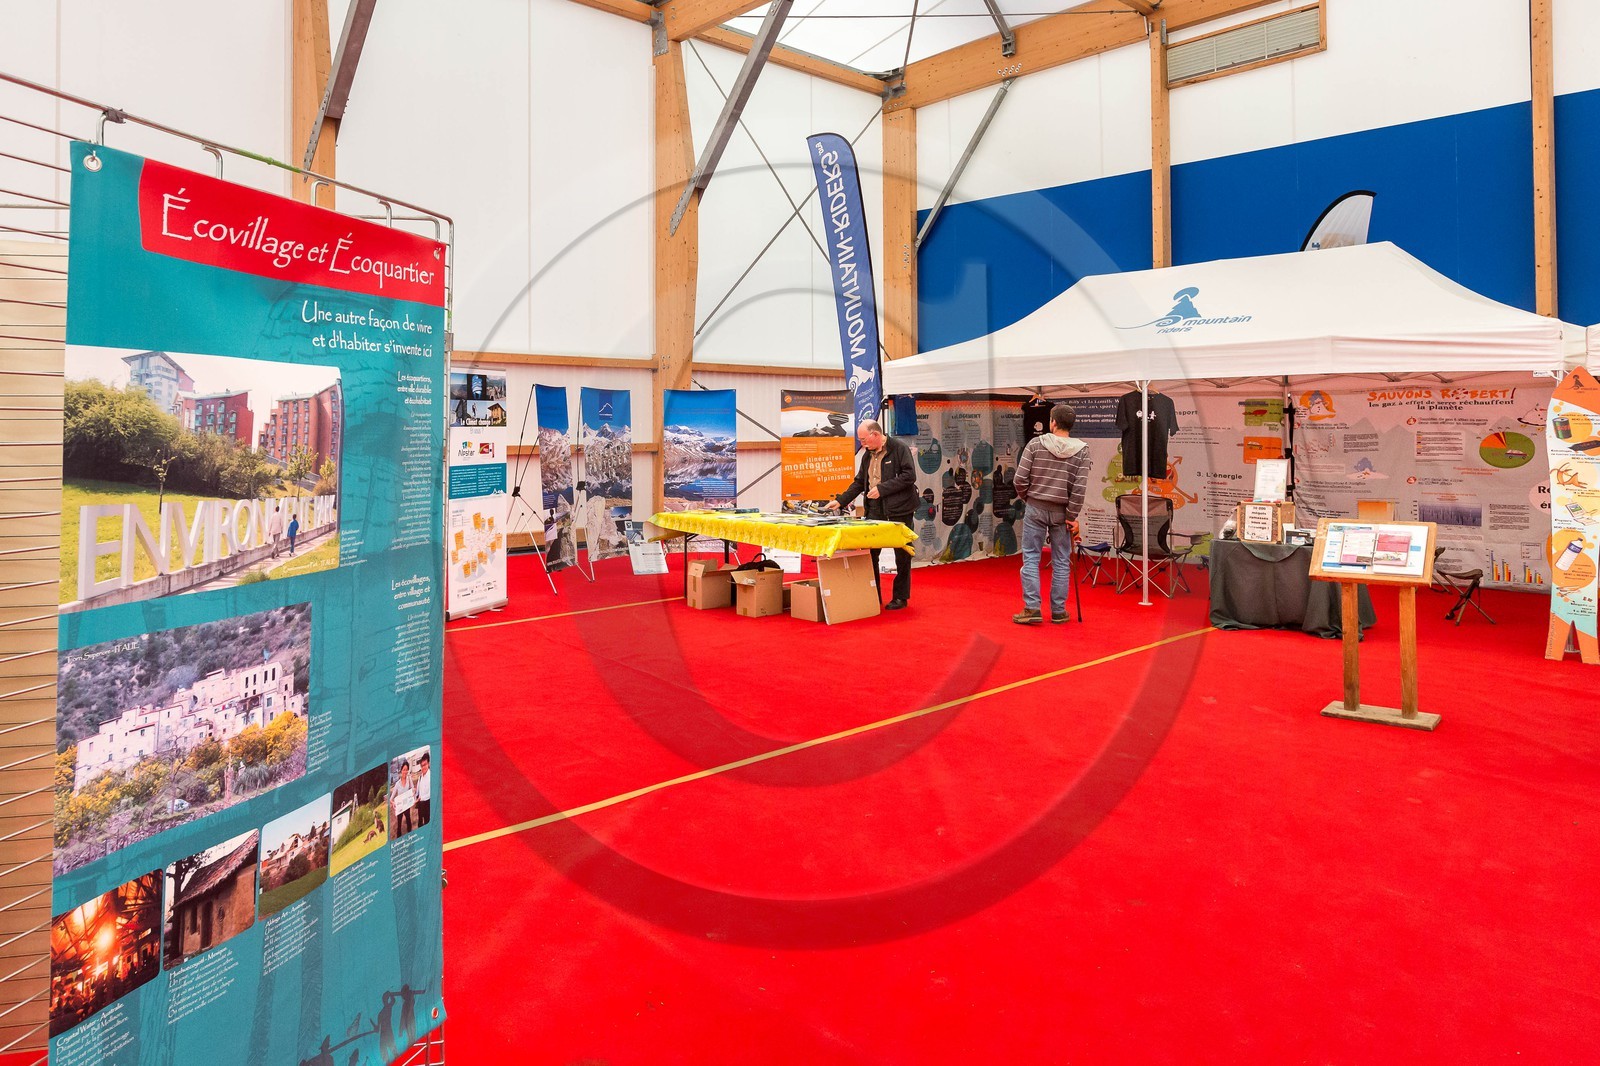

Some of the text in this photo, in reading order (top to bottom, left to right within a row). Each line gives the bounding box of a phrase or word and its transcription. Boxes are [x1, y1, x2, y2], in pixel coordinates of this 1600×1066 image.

[161, 187, 435, 288] Écovillage et Écoquartier
[301, 300, 433, 334] Une autre façon de vivre
[1182, 315, 1252, 327] mountain
[1156, 326, 1192, 334] riders
[312, 334, 433, 358] et d'habiter s'invente ici
[1367, 389, 1431, 401] SAUVONS
[807, 455, 843, 463] itinéraires
[784, 461, 833, 472] montagne
[817, 474, 851, 483] alpinisme
[1206, 472, 1243, 480] L'énergie
[391, 580, 400, 591] Les
[407, 586, 424, 597] village
